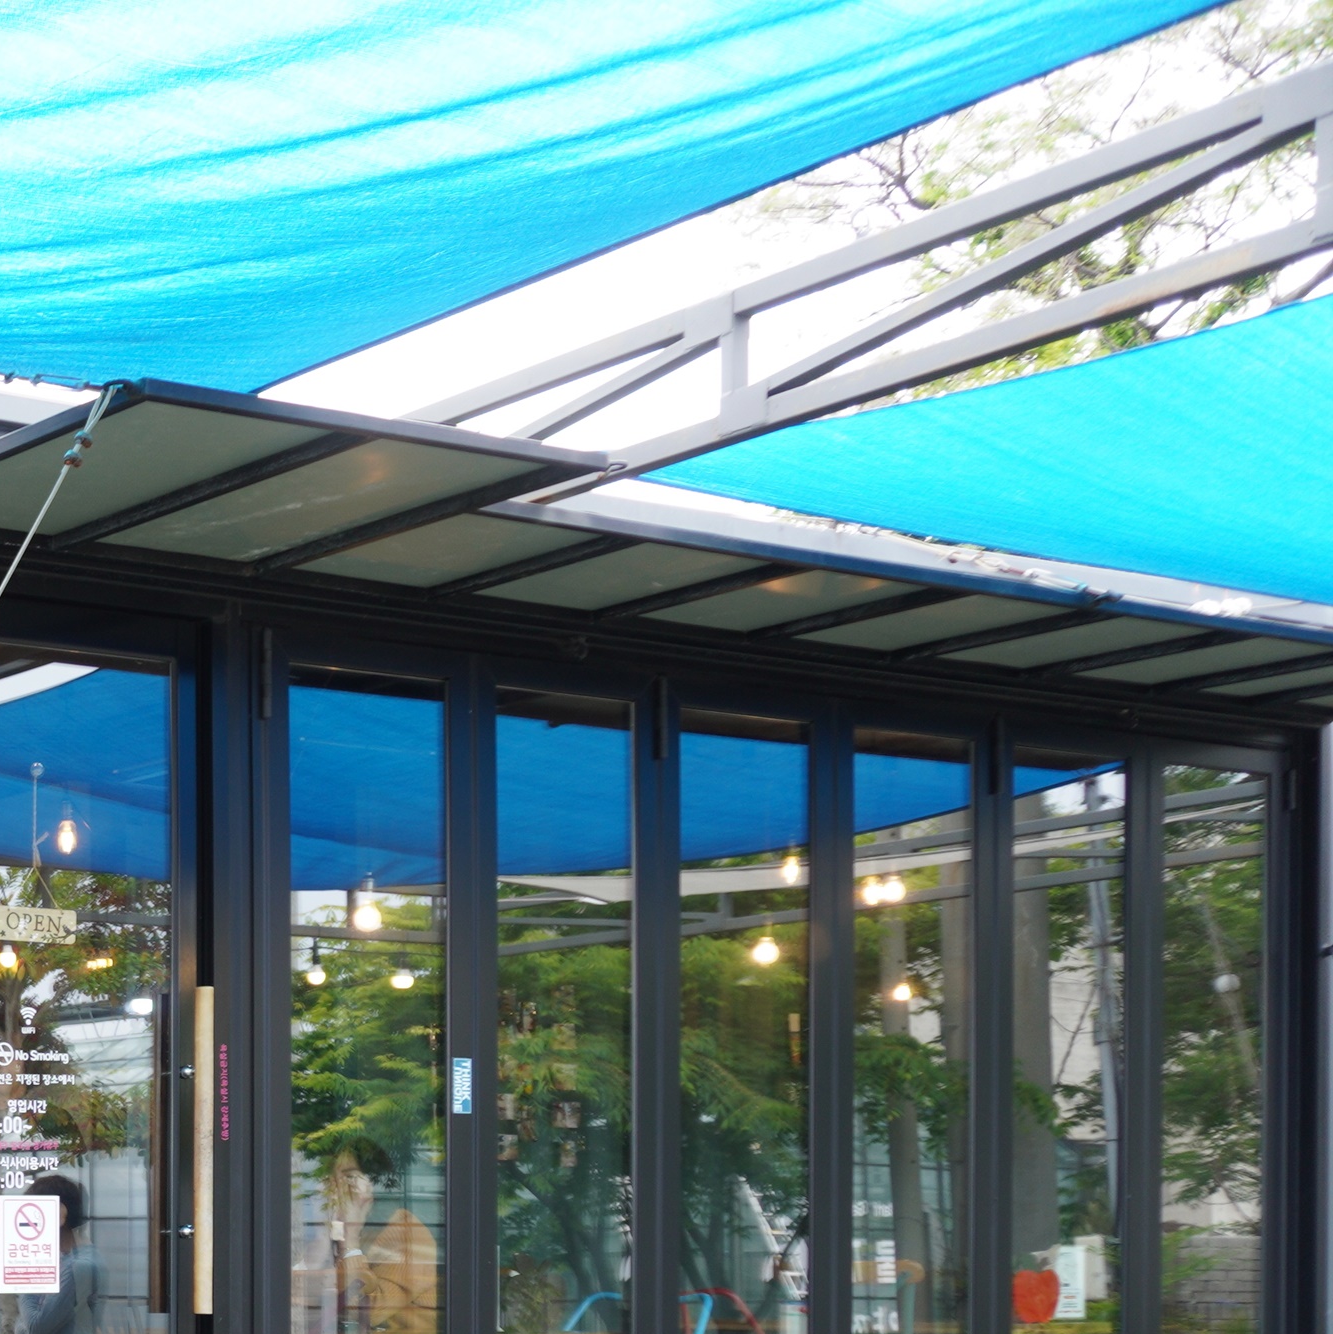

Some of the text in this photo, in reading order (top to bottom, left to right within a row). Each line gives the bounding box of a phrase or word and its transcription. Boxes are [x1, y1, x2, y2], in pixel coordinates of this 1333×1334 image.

[6, 912, 62, 933] OPEN
[14, 1050, 70, 1064] No Smoking
[15, 1073, 41, 1085] 지정된
[42, 1073, 75, 1086] 장소에서
[461, 1061, 471, 1100] THINK
[7, 1099, 48, 1114] 영업시간
[0, 1156, 60, 1170] 식사이용시간
[7, 1243, 53, 1258] 금연구역
